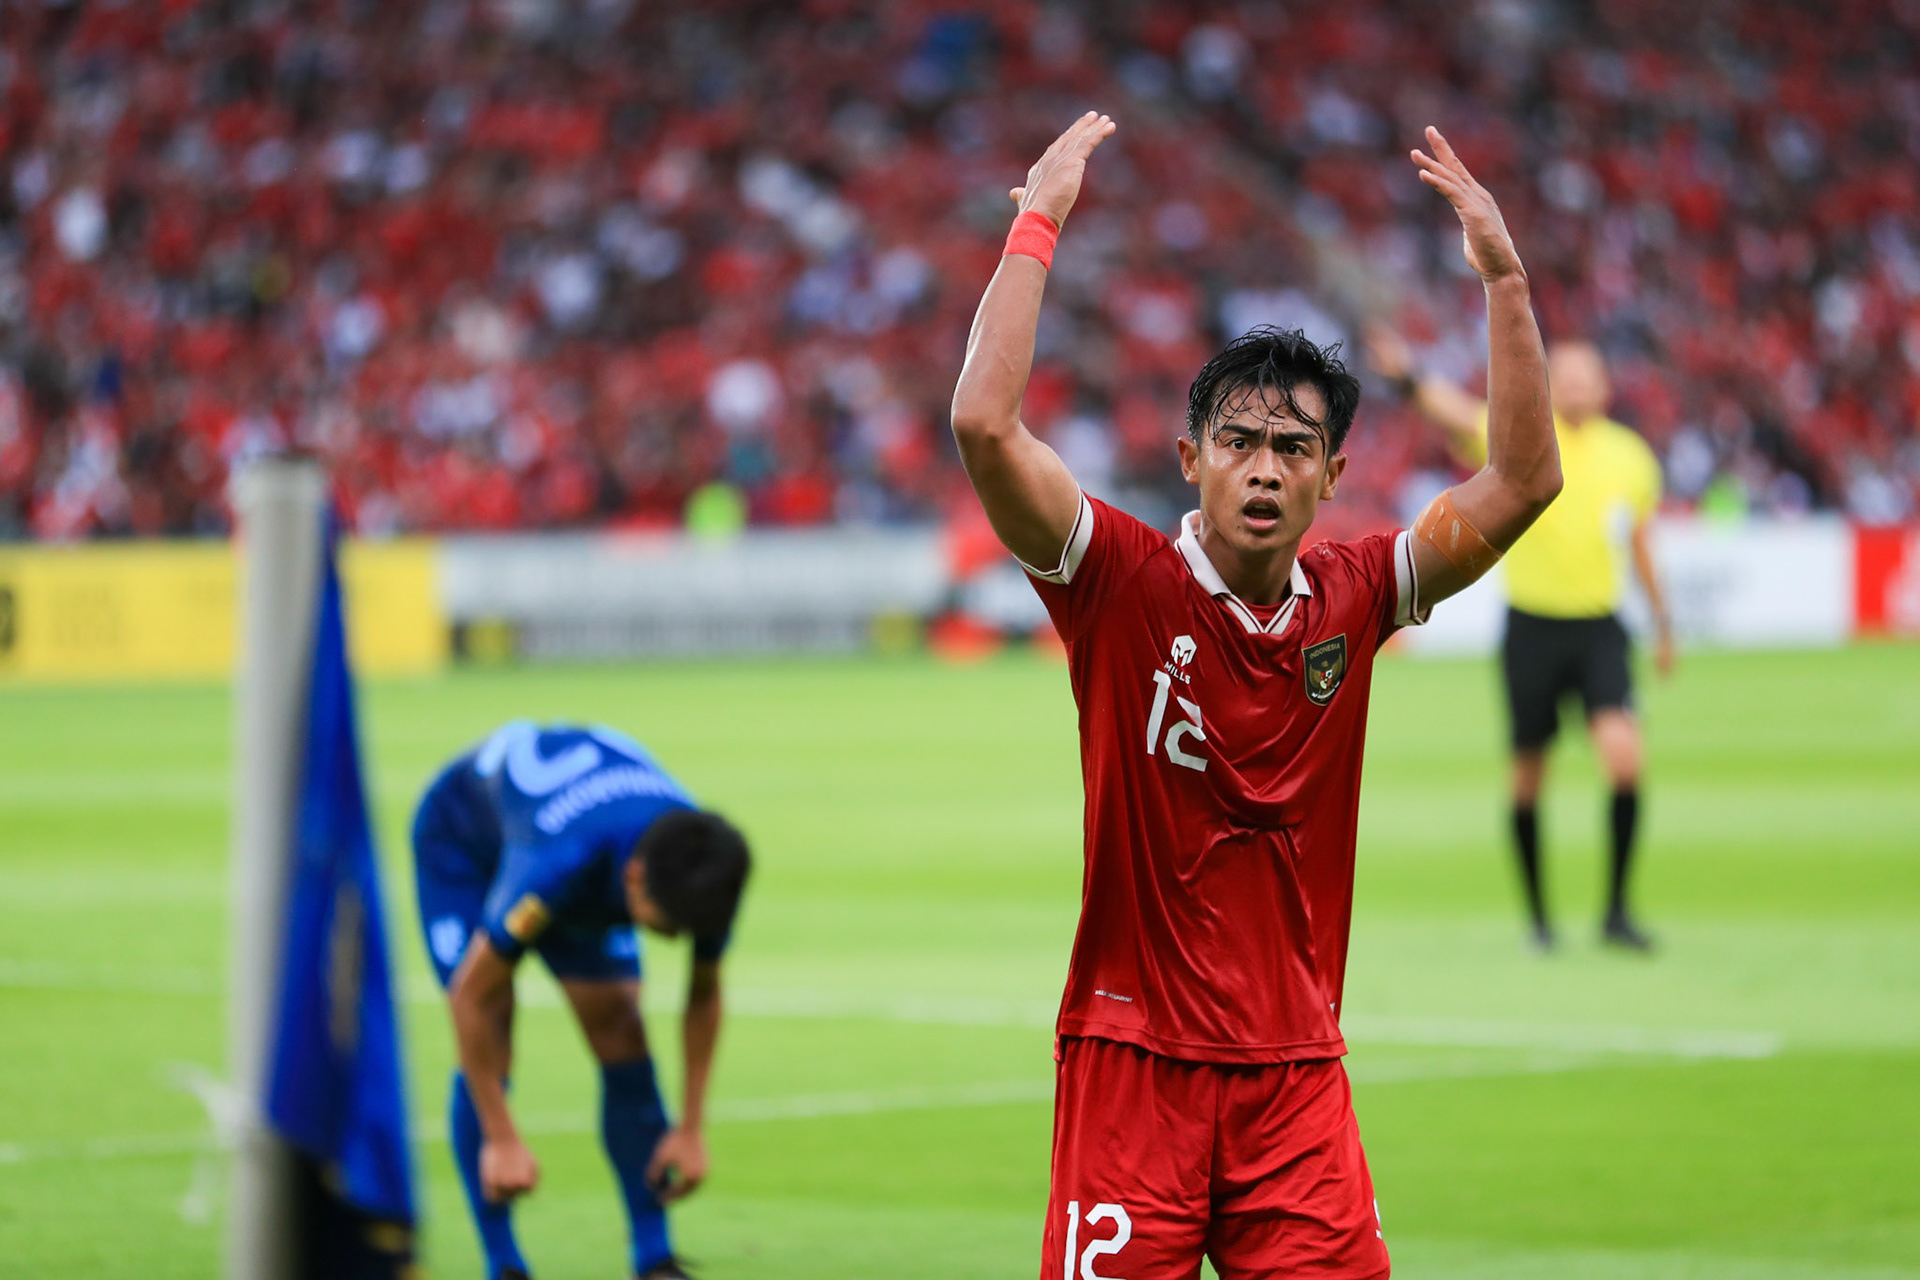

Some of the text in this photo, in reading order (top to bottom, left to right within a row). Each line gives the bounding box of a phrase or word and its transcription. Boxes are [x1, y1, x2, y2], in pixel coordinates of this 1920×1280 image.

[1163, 661, 1191, 685] MILLS
[1309, 642, 1341, 659] INDONESIA
[1146, 669, 1208, 773] 12
[1063, 1200, 1132, 1280] 12
